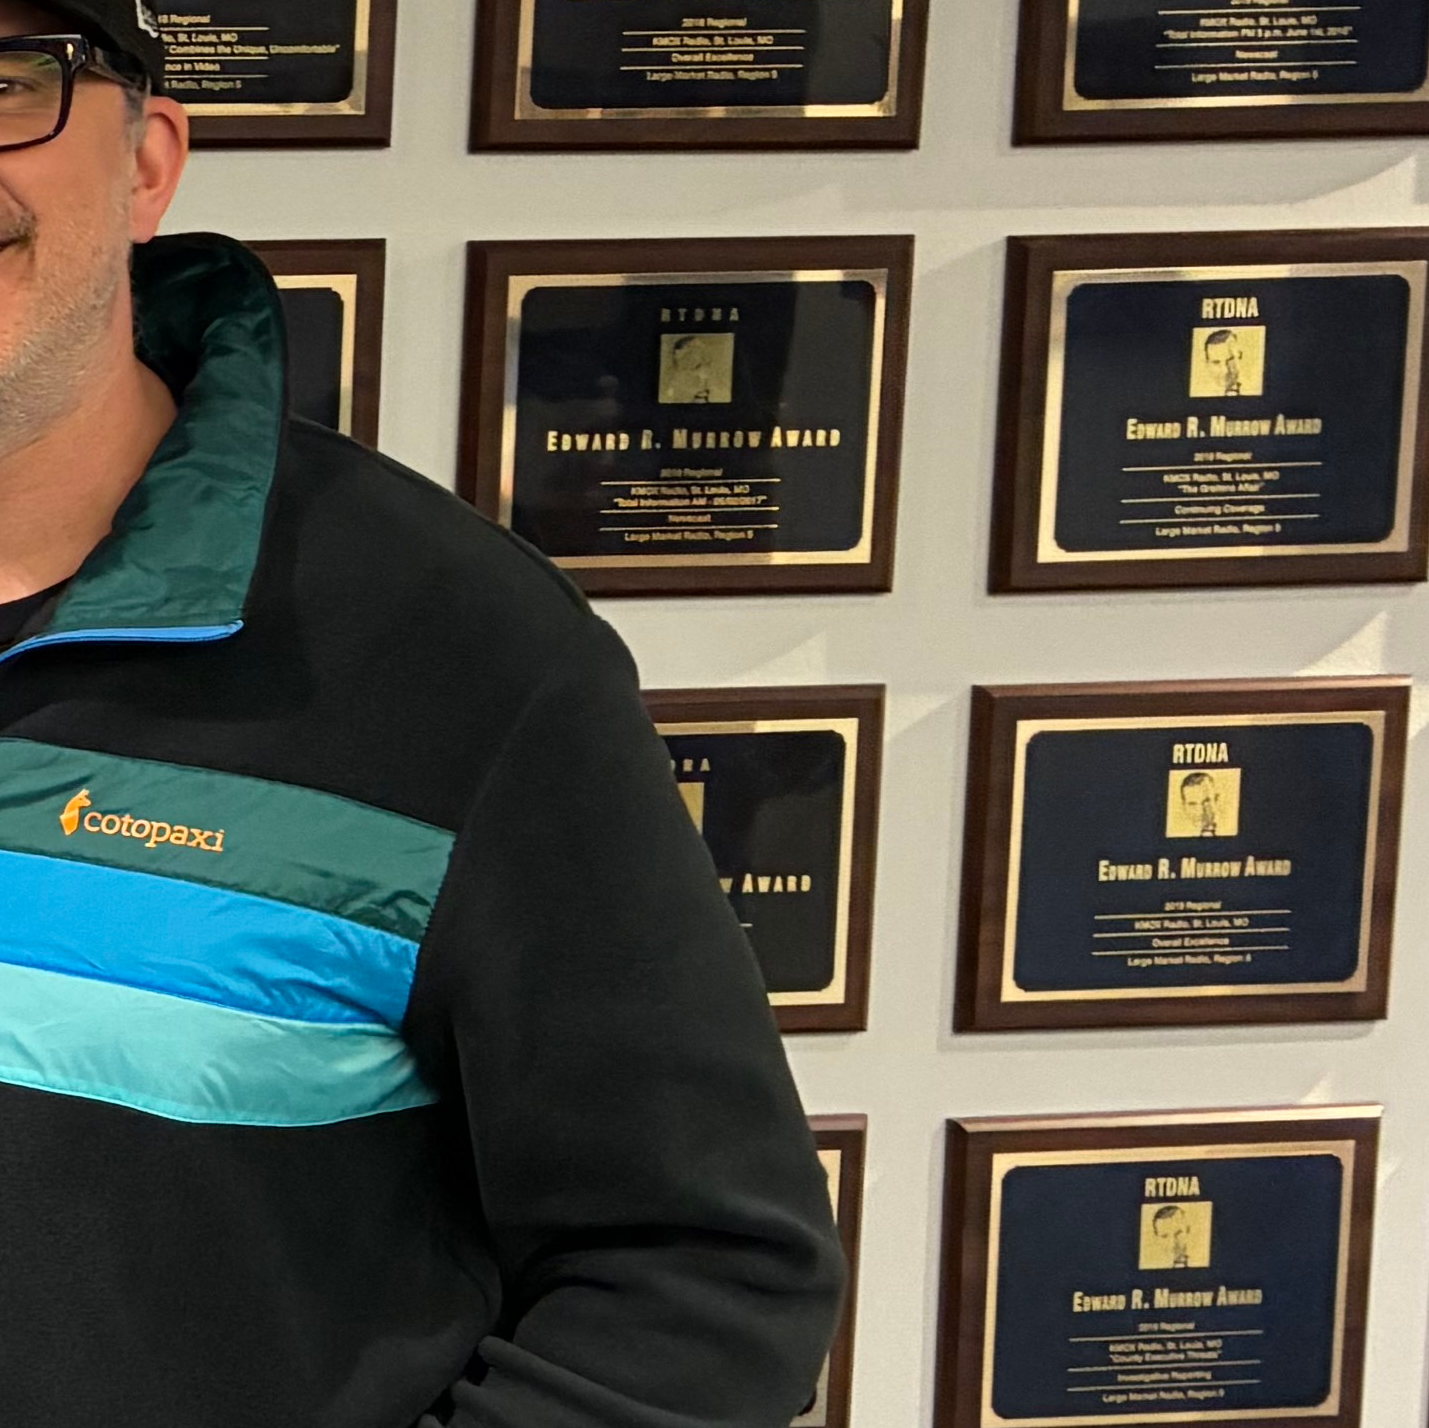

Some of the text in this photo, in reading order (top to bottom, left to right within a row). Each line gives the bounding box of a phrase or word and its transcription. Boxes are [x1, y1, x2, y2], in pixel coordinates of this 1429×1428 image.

[1201, 297, 1259, 319] RTDNA
[546, 426, 841, 451] EDWARD R. MURROW AWARD
[1126, 414, 1322, 440] EDWARD R. MURROW AWARD
[1172, 743, 1229, 764] RTDNA
[84, 811, 225, 852] cotopaxi
[1098, 855, 1292, 882] EDWARD R. MURROW AWARD
[742, 873, 812, 893] AWARD
[1144, 1176, 1200, 1198] RTDNA
[1072, 1285, 1263, 1313] EDWARD R. MURROW AWARD
